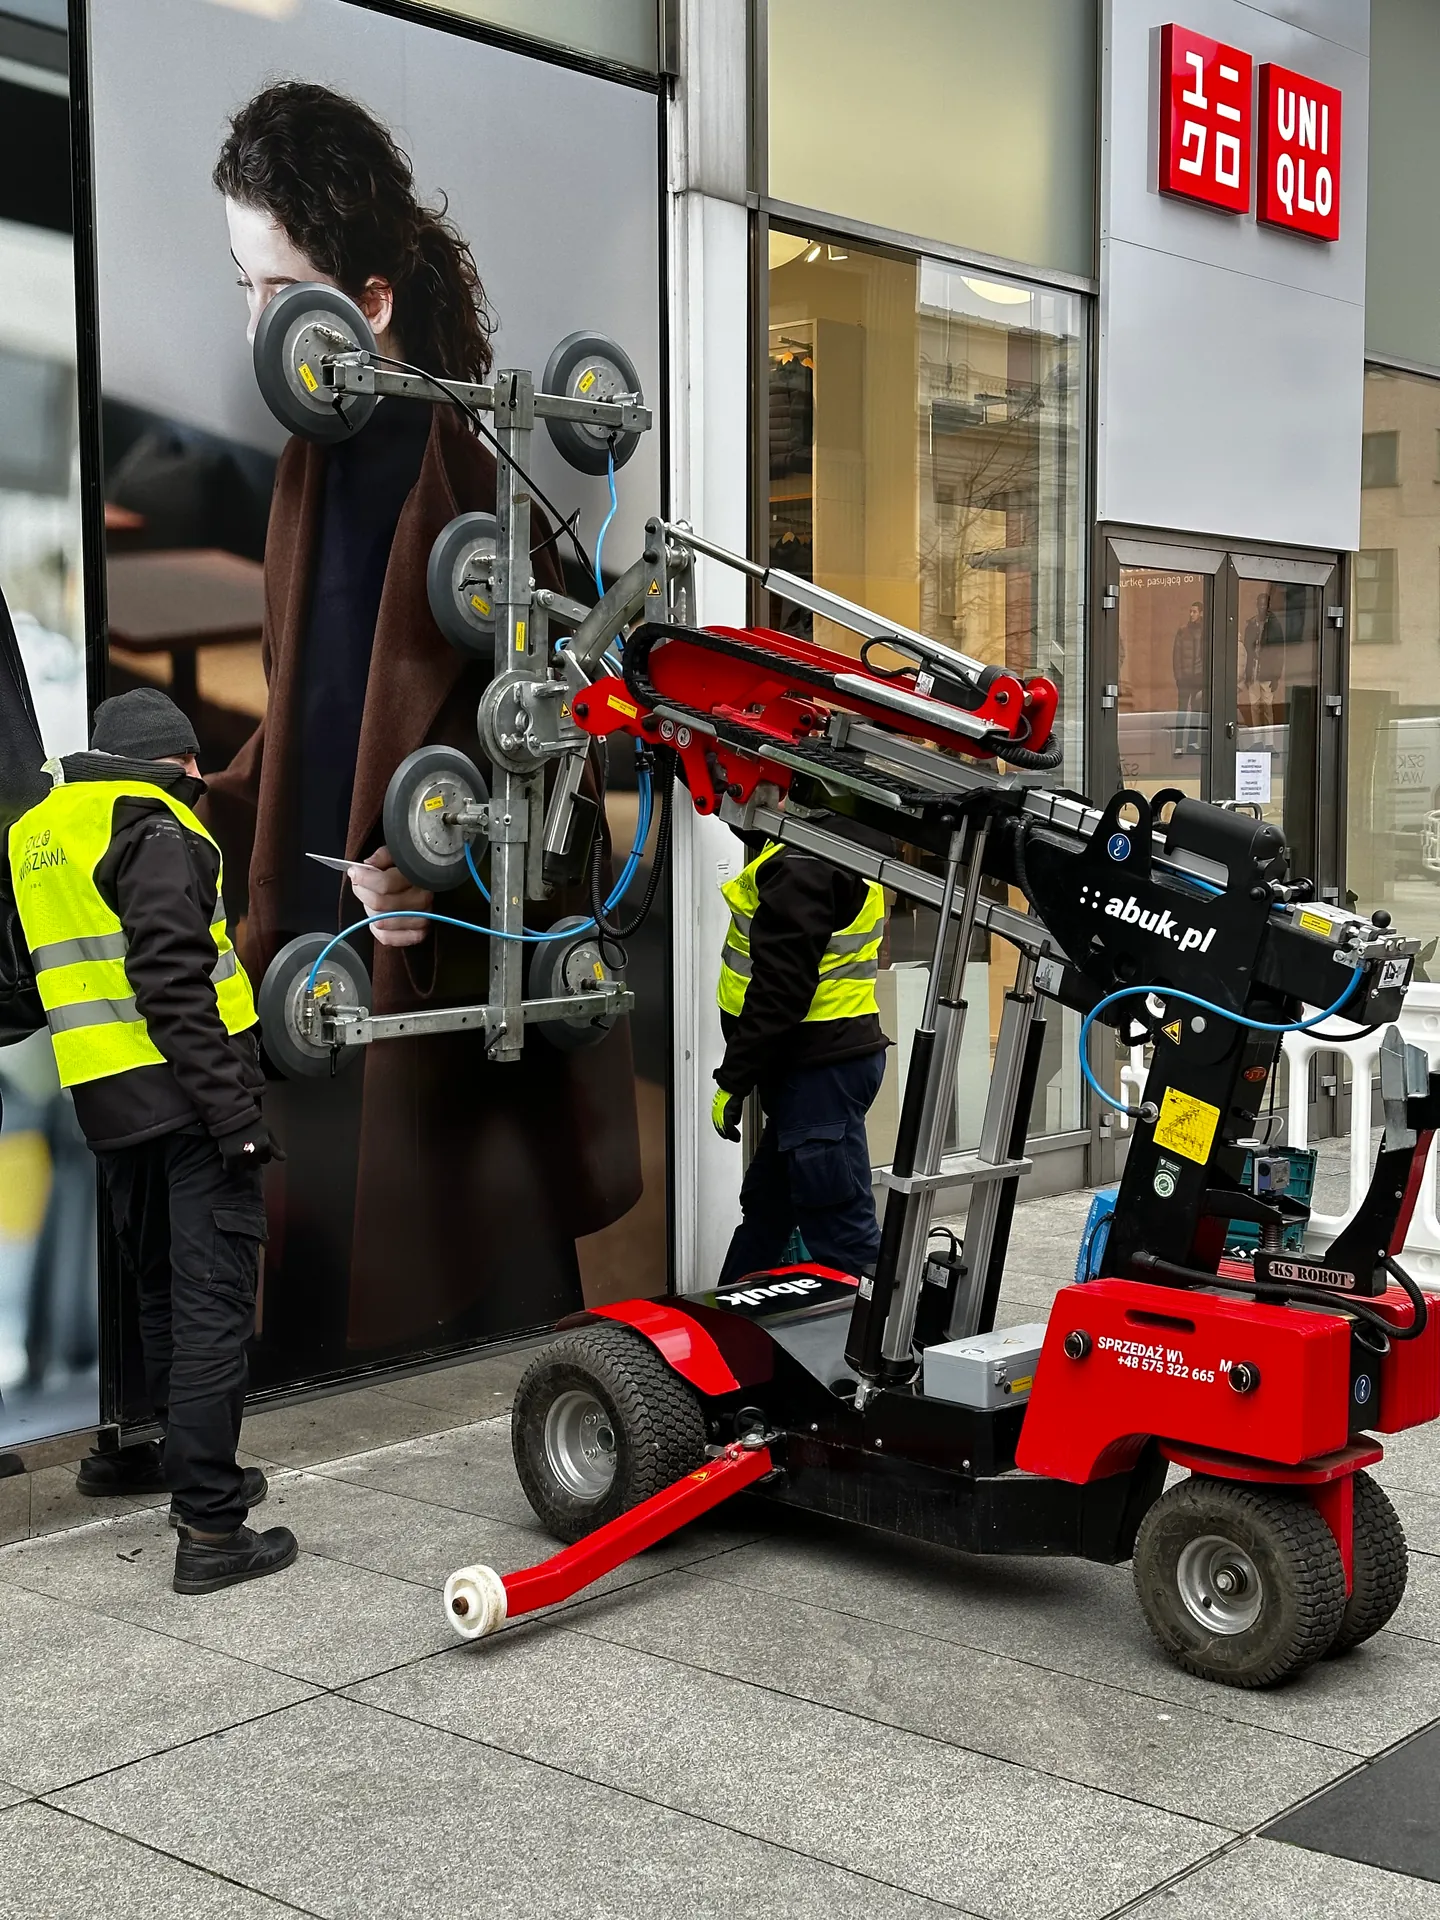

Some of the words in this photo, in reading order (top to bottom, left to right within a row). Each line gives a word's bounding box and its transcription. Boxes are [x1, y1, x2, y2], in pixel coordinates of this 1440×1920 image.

[1277, 87, 1329, 155] UNI
[1276, 153, 1332, 216] QLO
[1183, 573, 1194, 583] do
[1104, 896, 1217, 953] abuk.pl
[1274, 1263, 1293, 1278] KS
[1297, 1267, 1348, 1286] ROBOT
[715, 1278, 822, 1306] abuk
[1098, 1336, 1164, 1360] SPRZEDAŻ
[1118, 1355, 1139, 1369] +48
[1141, 1359, 1164, 1373] 575
[1166, 1363, 1189, 1378] 322
[1192, 1368, 1215, 1383] 665
